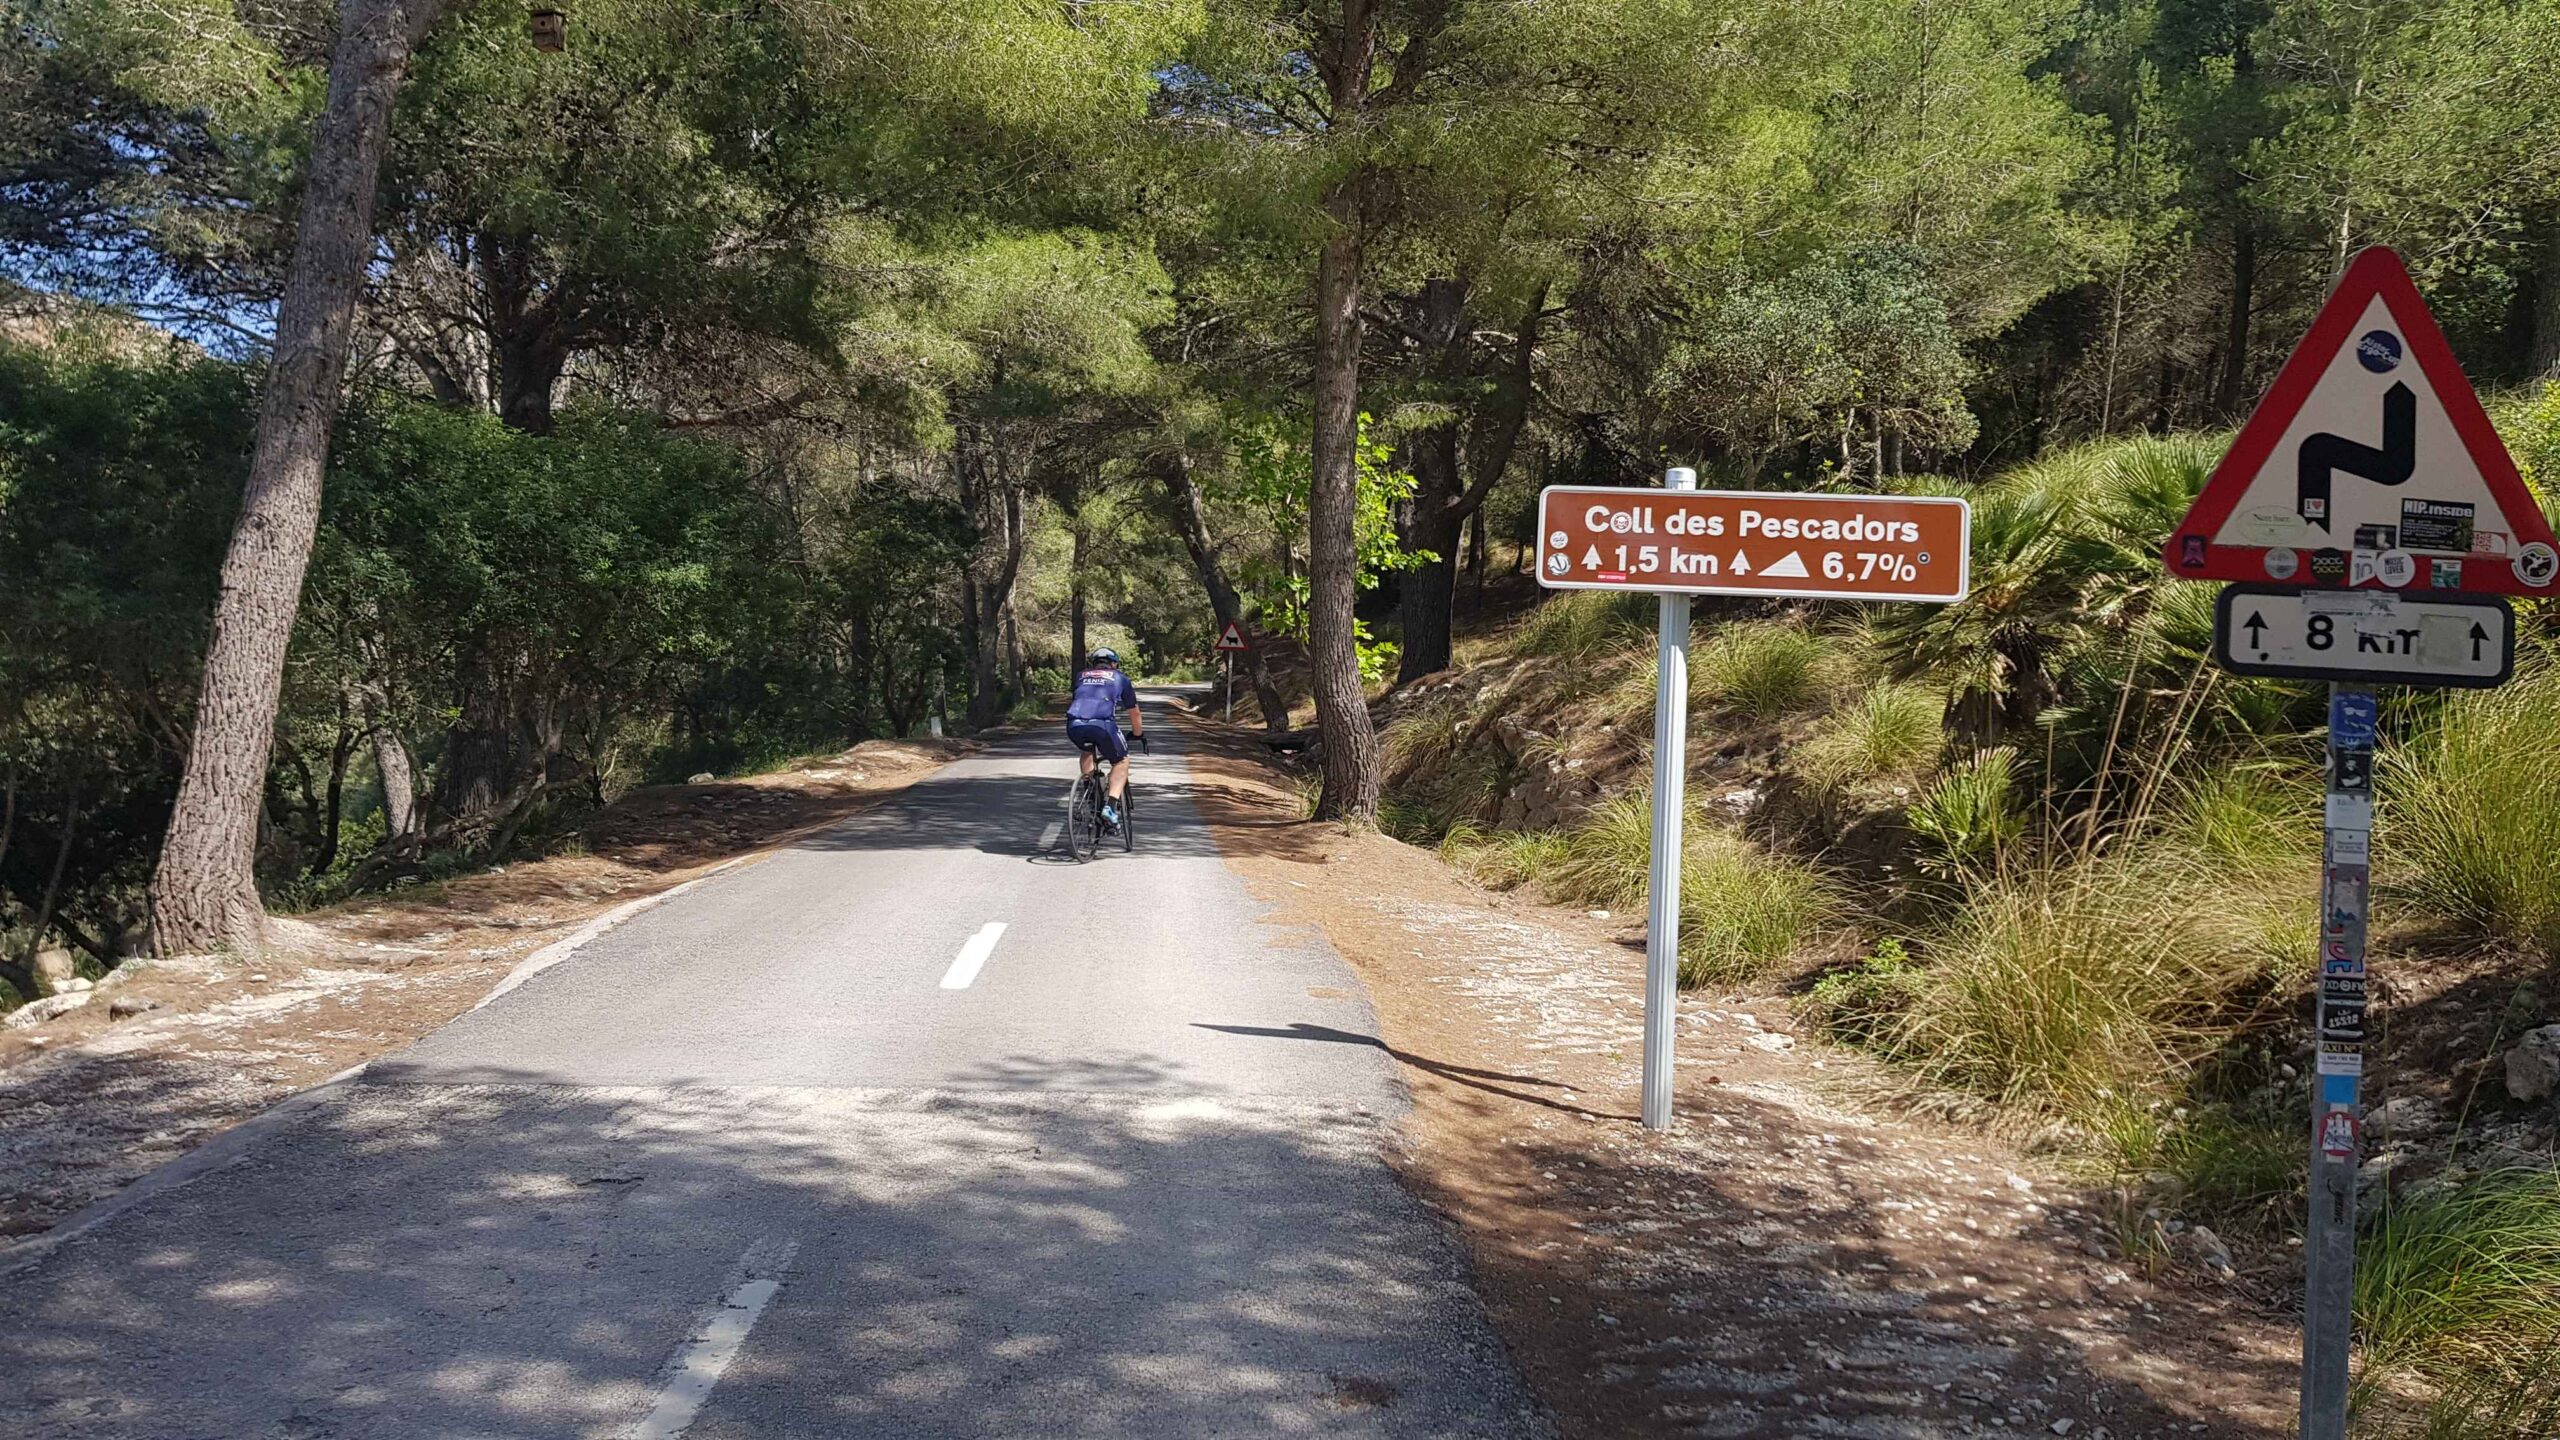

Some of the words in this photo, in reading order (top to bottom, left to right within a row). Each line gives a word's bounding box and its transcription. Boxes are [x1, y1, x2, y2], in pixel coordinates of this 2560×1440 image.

[1584, 505, 1655, 533] Coll
[1664, 508, 1724, 536] des
[1739, 510, 1919, 542] Pescadors
[1615, 545, 1659, 574] 1,5
[1670, 546, 1718, 574] km
[1822, 551, 1916, 582] 6,7%
[2307, 615, 2334, 650] 8
